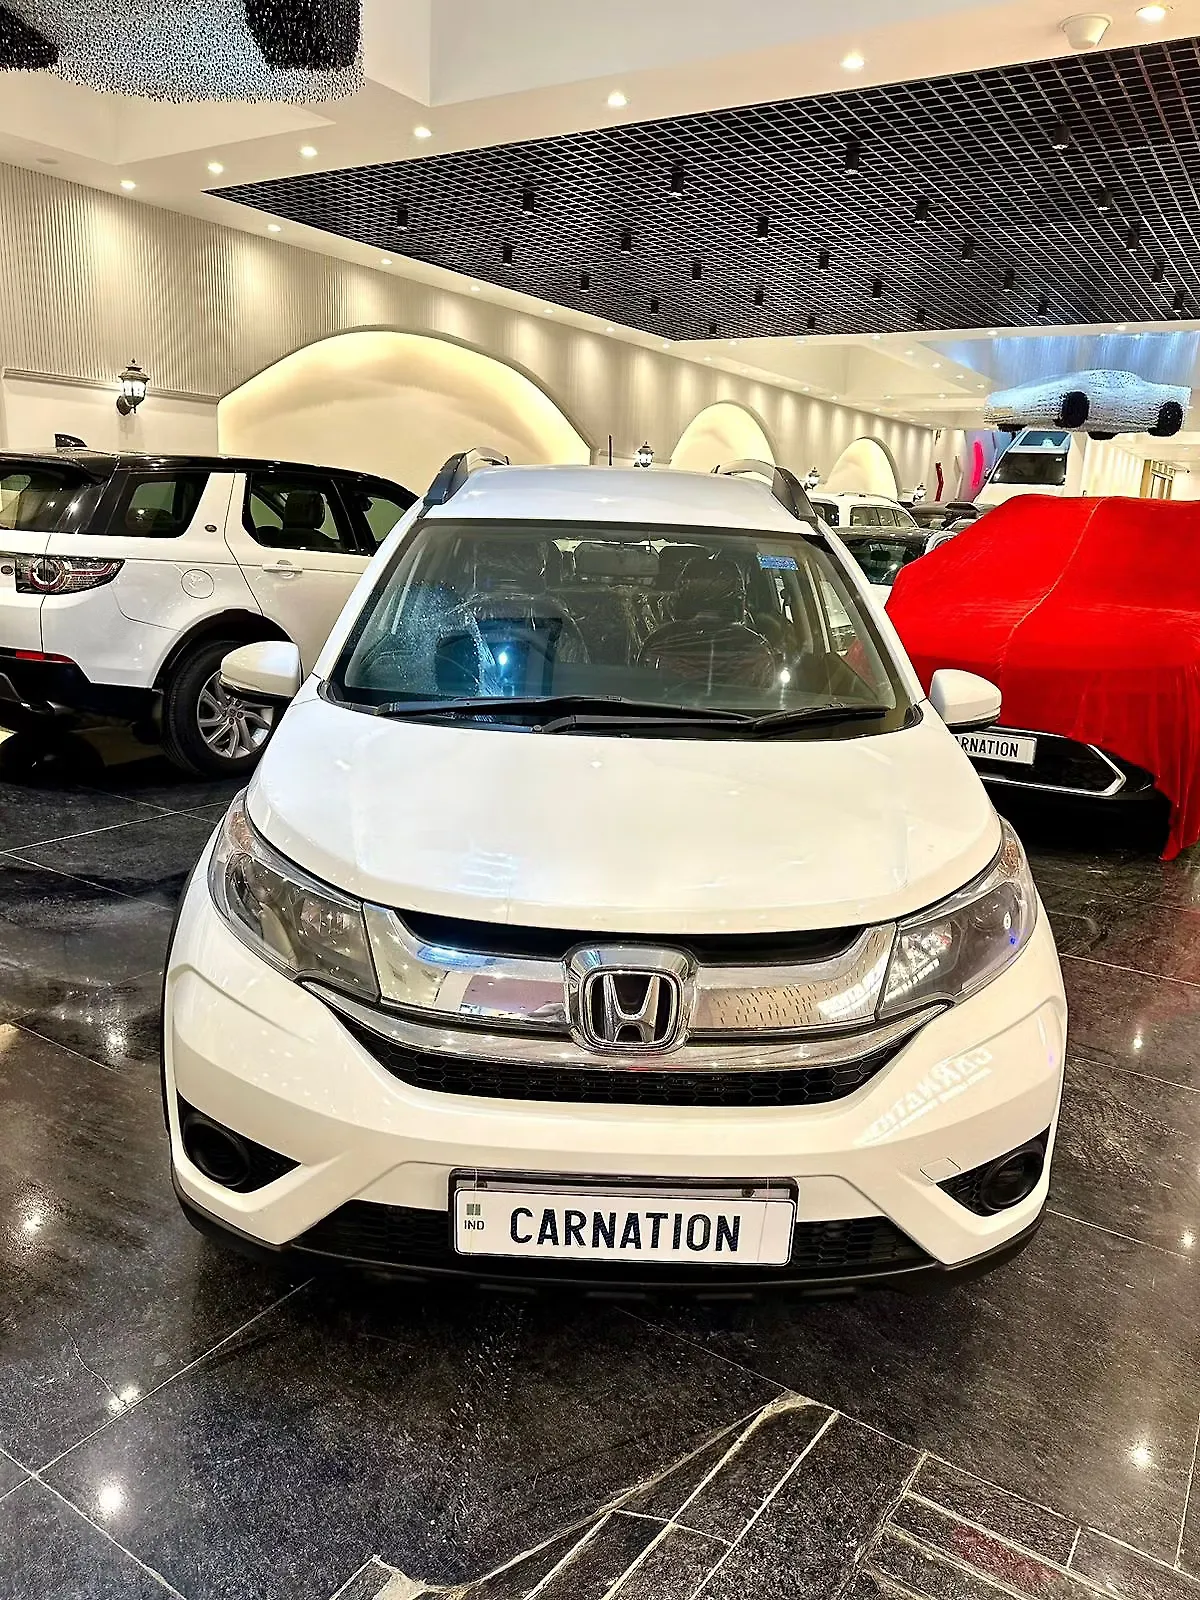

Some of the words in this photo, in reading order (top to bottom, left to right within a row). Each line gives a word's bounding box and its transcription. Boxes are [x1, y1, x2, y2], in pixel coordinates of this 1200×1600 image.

[955, 736, 1019, 758] RNATION
[464, 1219, 485, 1231] IND
[510, 1207, 742, 1253] CARNATION
